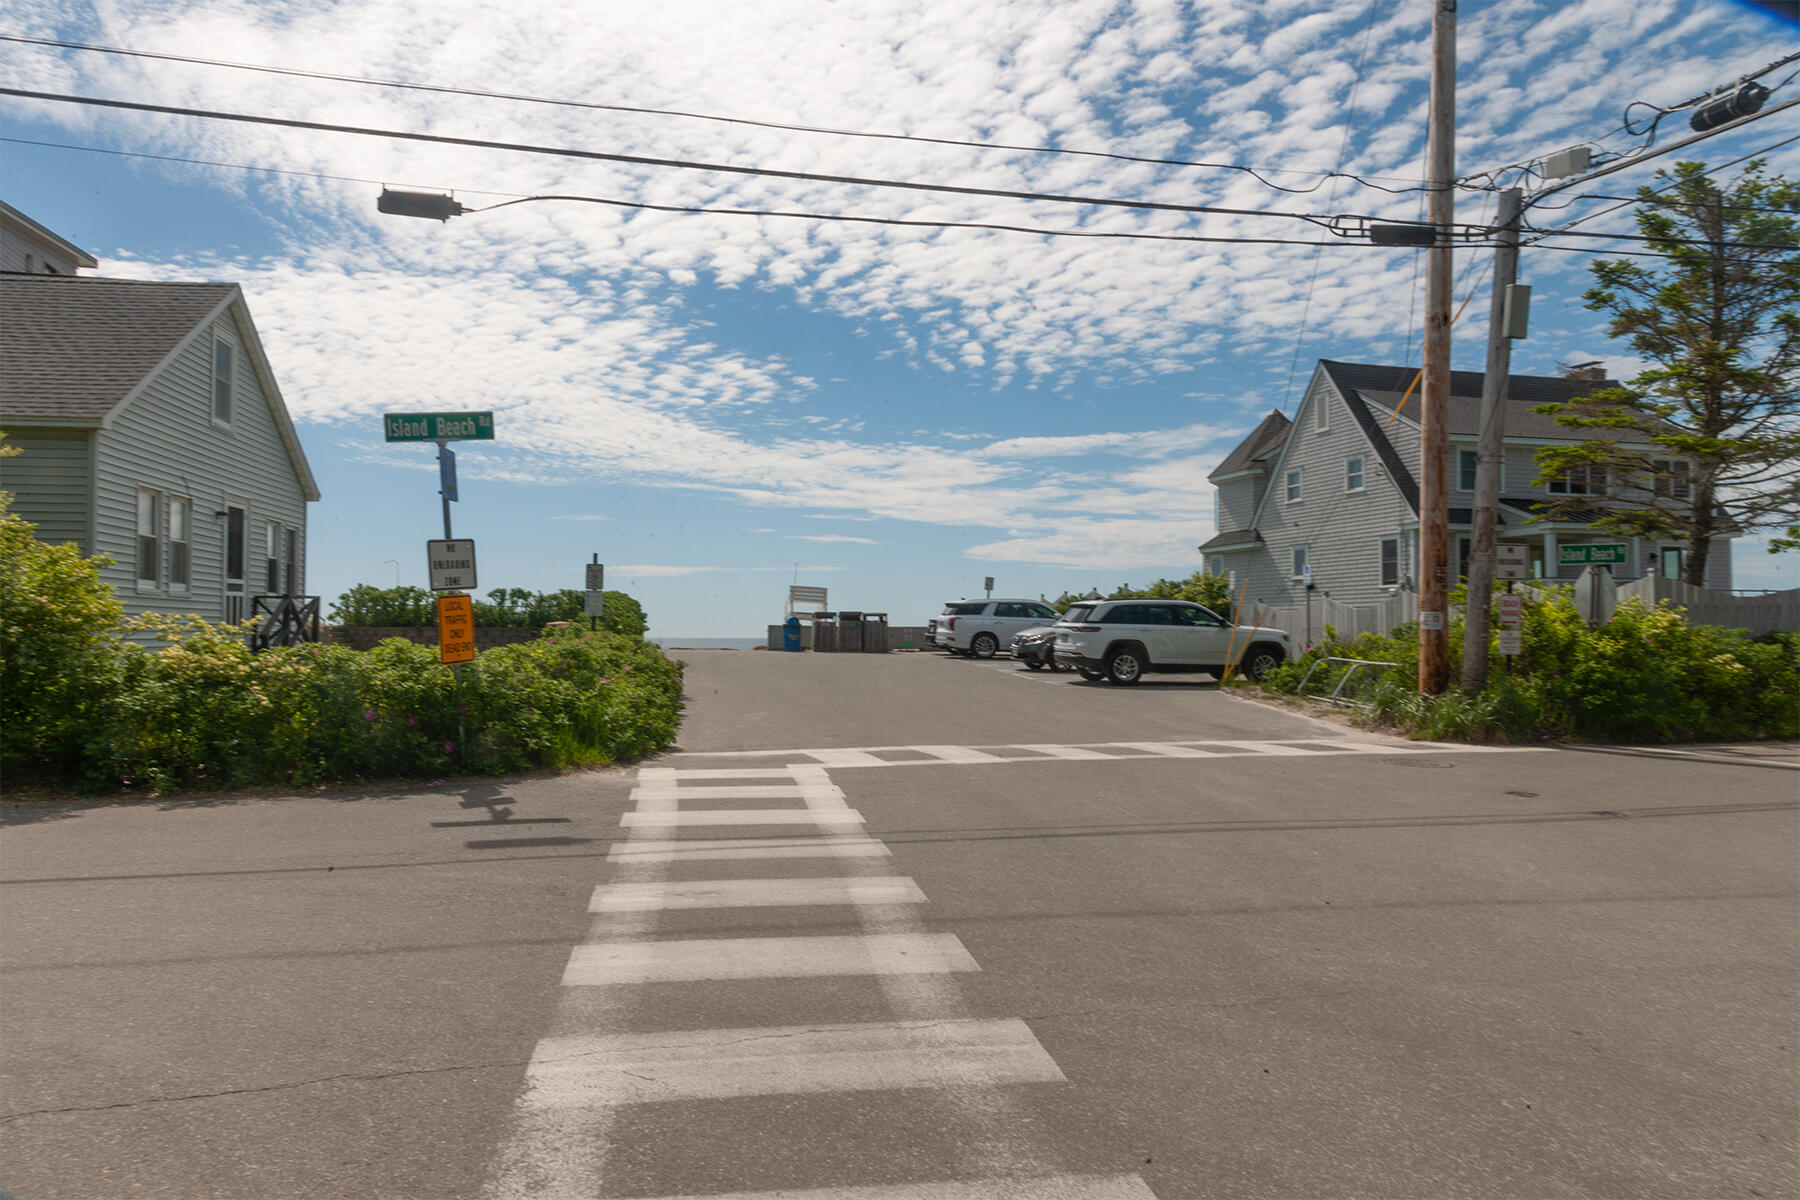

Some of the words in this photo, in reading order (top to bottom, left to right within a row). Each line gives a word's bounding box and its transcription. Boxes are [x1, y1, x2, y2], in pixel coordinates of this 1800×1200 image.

[387, 418, 428, 437] Island
[437, 417, 476, 436] Beach
[479, 415, 491, 426] Rd
[444, 614, 468, 625] TRAFFIC
